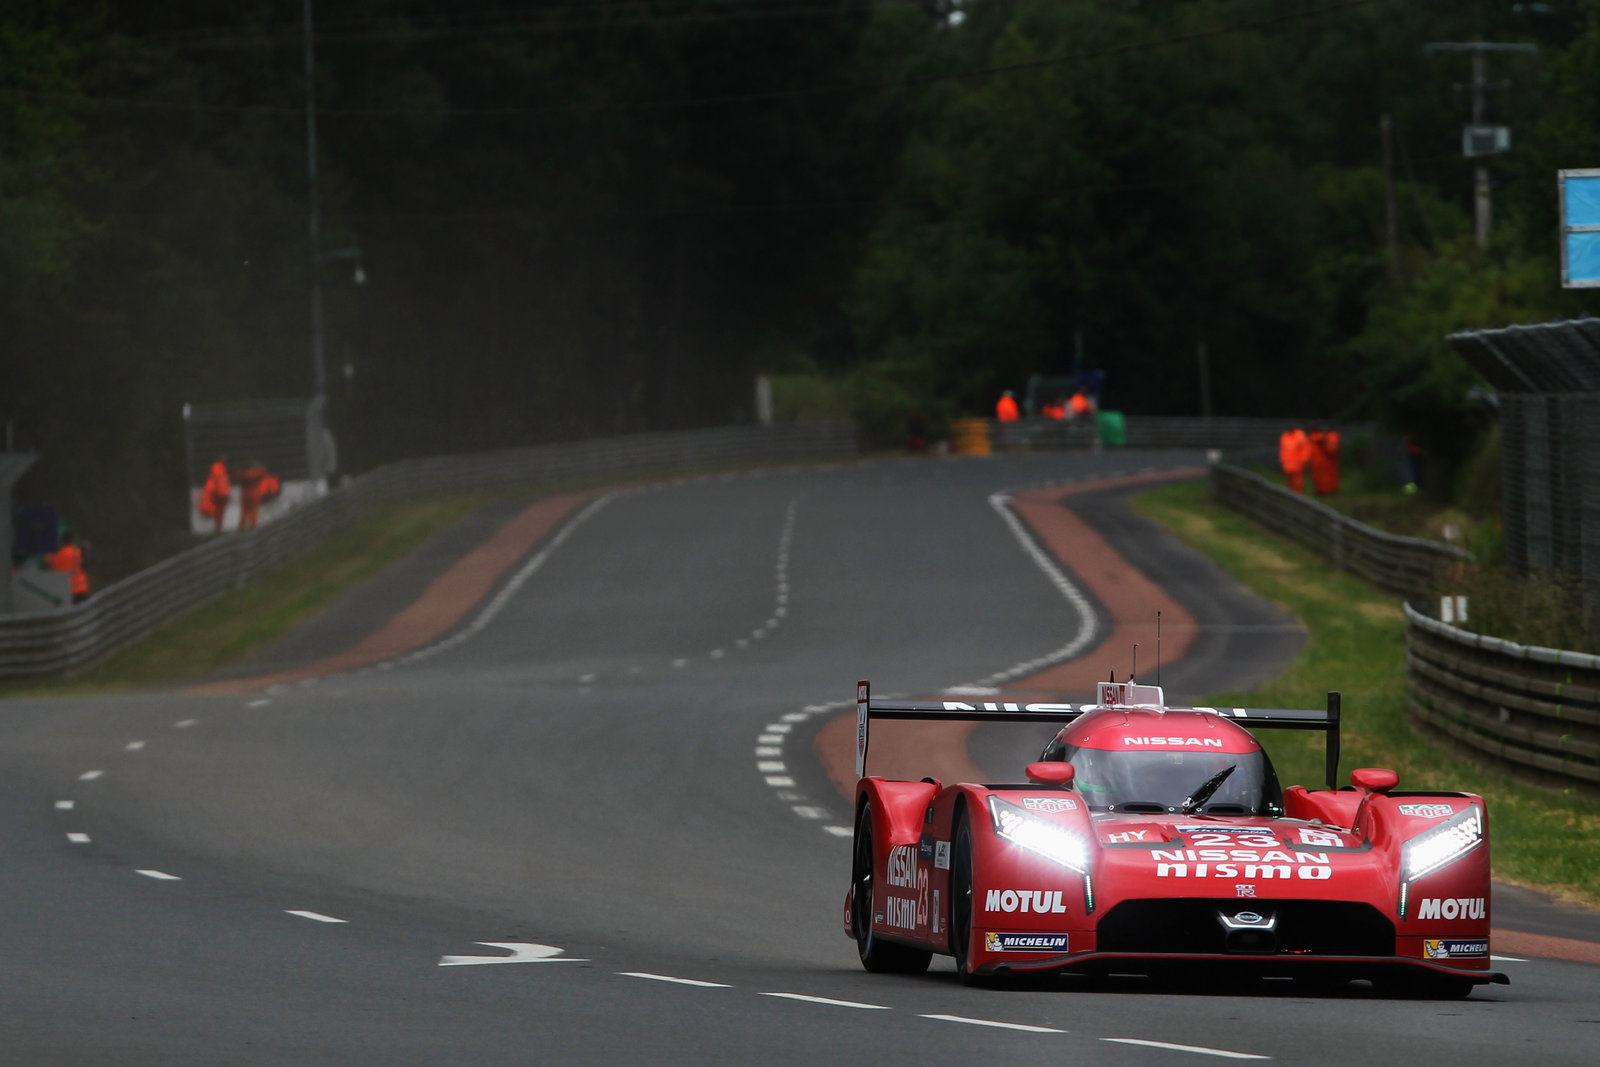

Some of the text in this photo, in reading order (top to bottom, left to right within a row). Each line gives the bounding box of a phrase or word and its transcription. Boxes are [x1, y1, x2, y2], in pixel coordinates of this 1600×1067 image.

[1124, 737, 1222, 747] NISSAN
[1108, 830, 1147, 843] HY
[1190, 833, 1281, 847] 23
[1151, 849, 1329, 864] NISSAN
[887, 845, 918, 889] NISSAN
[1156, 863, 1332, 880] nismo
[917, 868, 929, 926] 23
[985, 889, 1067, 913] MOTUL
[887, 896, 916, 930] nismo
[1417, 898, 1486, 920] MOTUL
[1004, 936, 1066, 947] MICHELIN
[1450, 943, 1488, 953] MICHELIN
